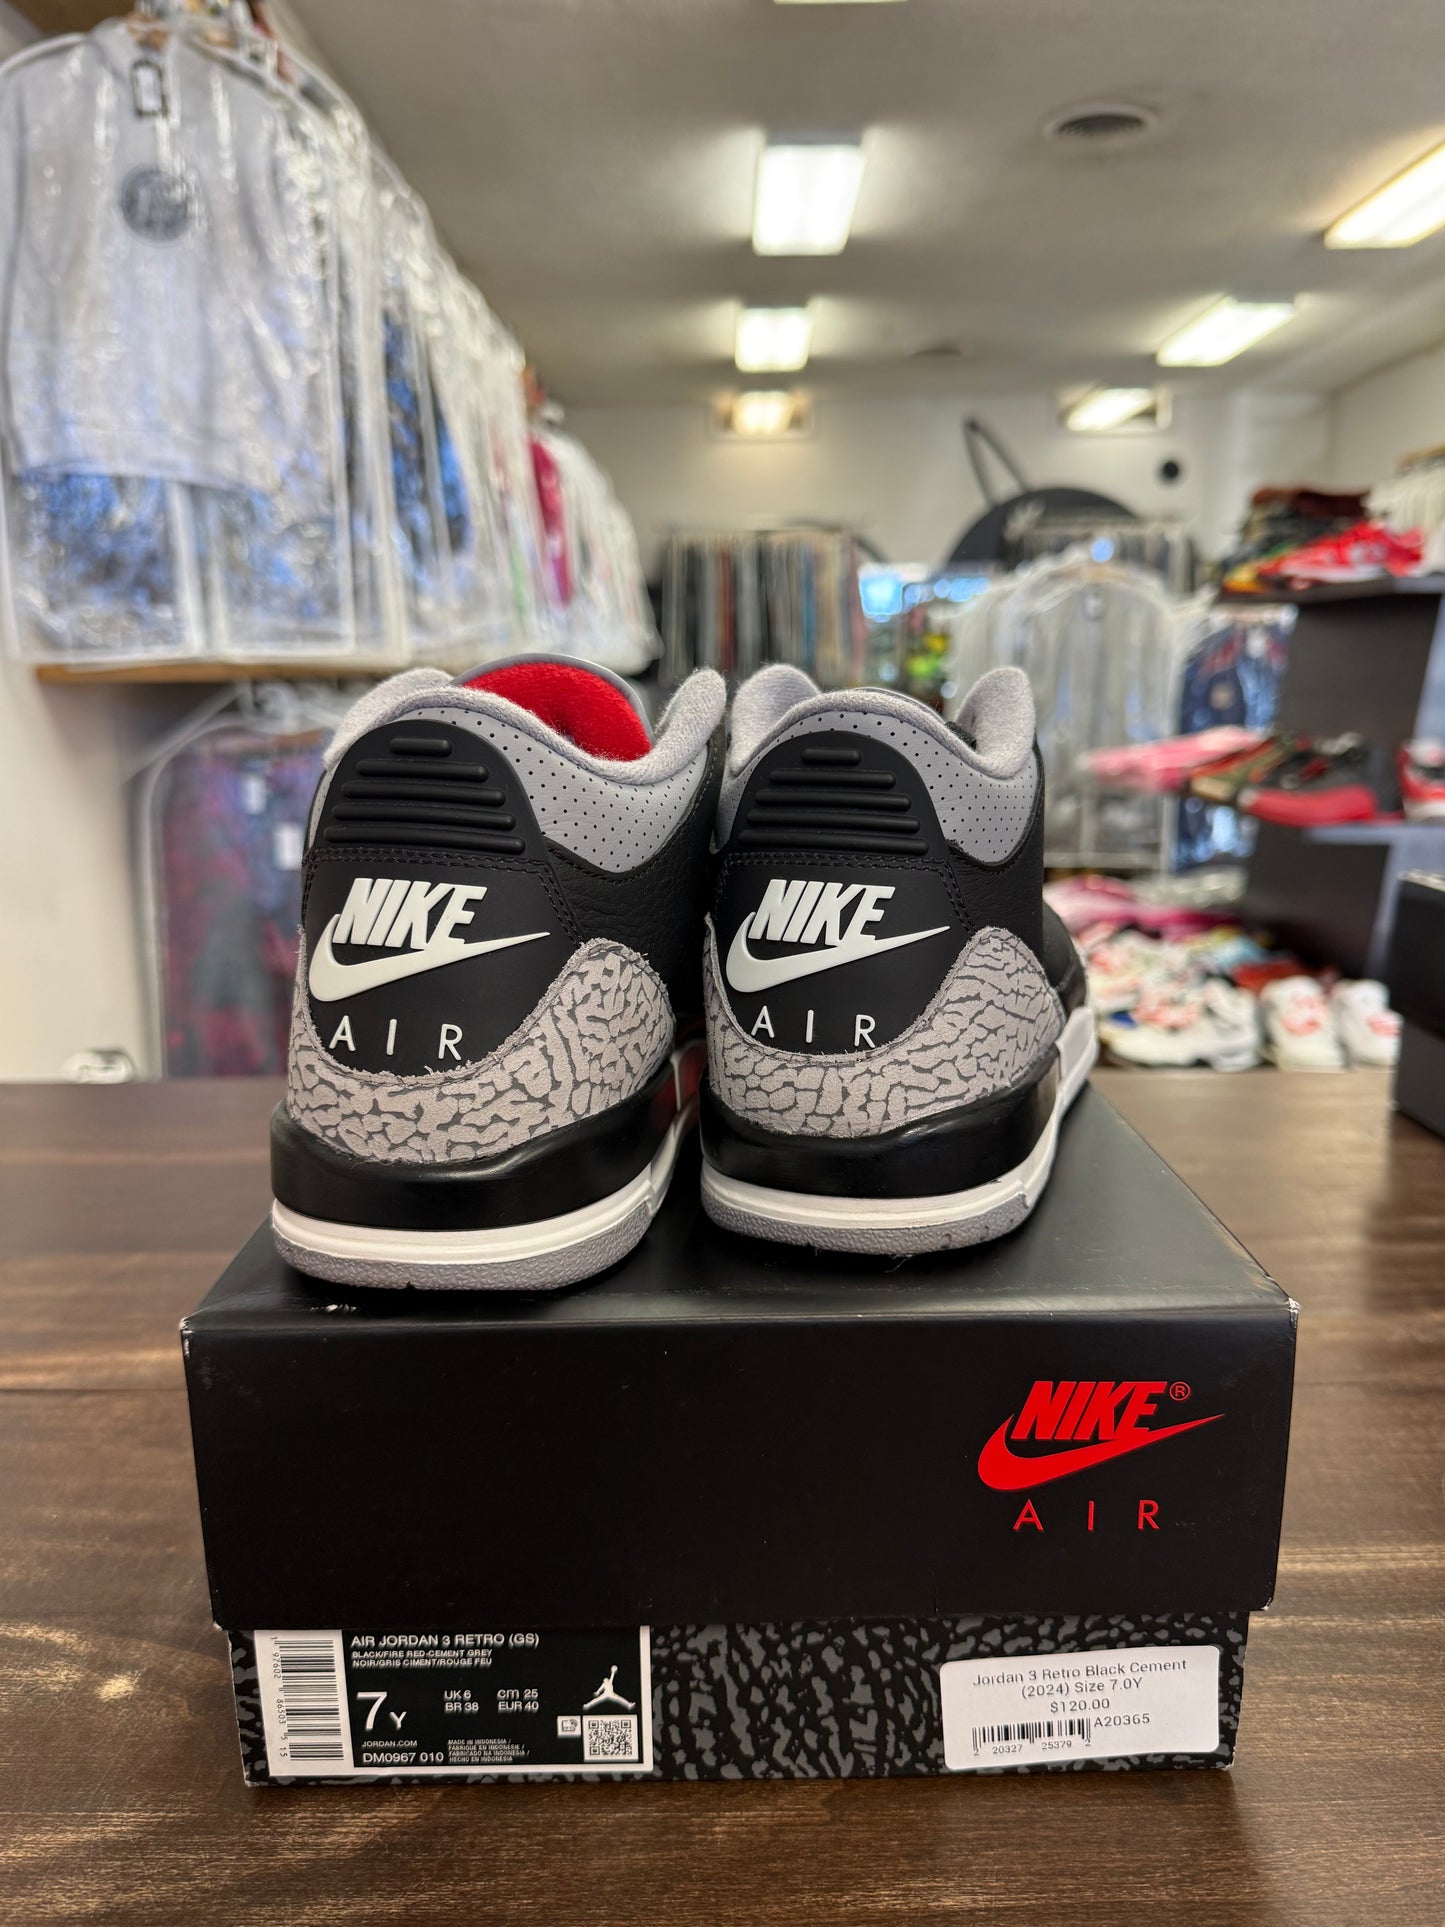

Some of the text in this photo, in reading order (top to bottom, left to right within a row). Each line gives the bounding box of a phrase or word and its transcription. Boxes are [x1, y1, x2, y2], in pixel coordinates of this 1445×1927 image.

[332, 877, 488, 950] NIKE
[748, 878, 896, 947] NIKE
[751, 1005, 876, 1049] AIR
[329, 1015, 463, 1061] AIR
[1010, 1380, 1168, 1440] NIKE
[1013, 1498, 1160, 1532] AIR
[351, 1633, 540, 1648] AIR JORDAN 3 RETRO (GS)
[352, 1649, 493, 1659] BLACK/FIRE RED-CEMENT GREY
[353, 1657, 493, 1668] NOIR/GRIS CIMENT/ROUGE FEU
[272, 1651, 282, 1679] 97602
[973, 1659, 1187, 1687] Jordan 3 Retro Black Cement
[444, 1690, 472, 1701] UK 6
[523, 1689, 539, 1699] 25
[1021, 1677, 1143, 1699] (2024) Size 7.0Y
[276, 1698, 287, 1725] 86503
[357, 1691, 407, 1732] 7 Y
[444, 1702, 479, 1712] BR 38
[498, 1701, 540, 1712] EUR 40
[1049, 1697, 1111, 1714] $120.00
[1093, 1713, 1151, 1728] A20365
[362, 1739, 418, 1748] JORDAN.COM
[992, 1744, 1024, 1755] 20327
[1041, 1740, 1072, 1751] 25379
[363, 1751, 445, 1764] DM0967 010
